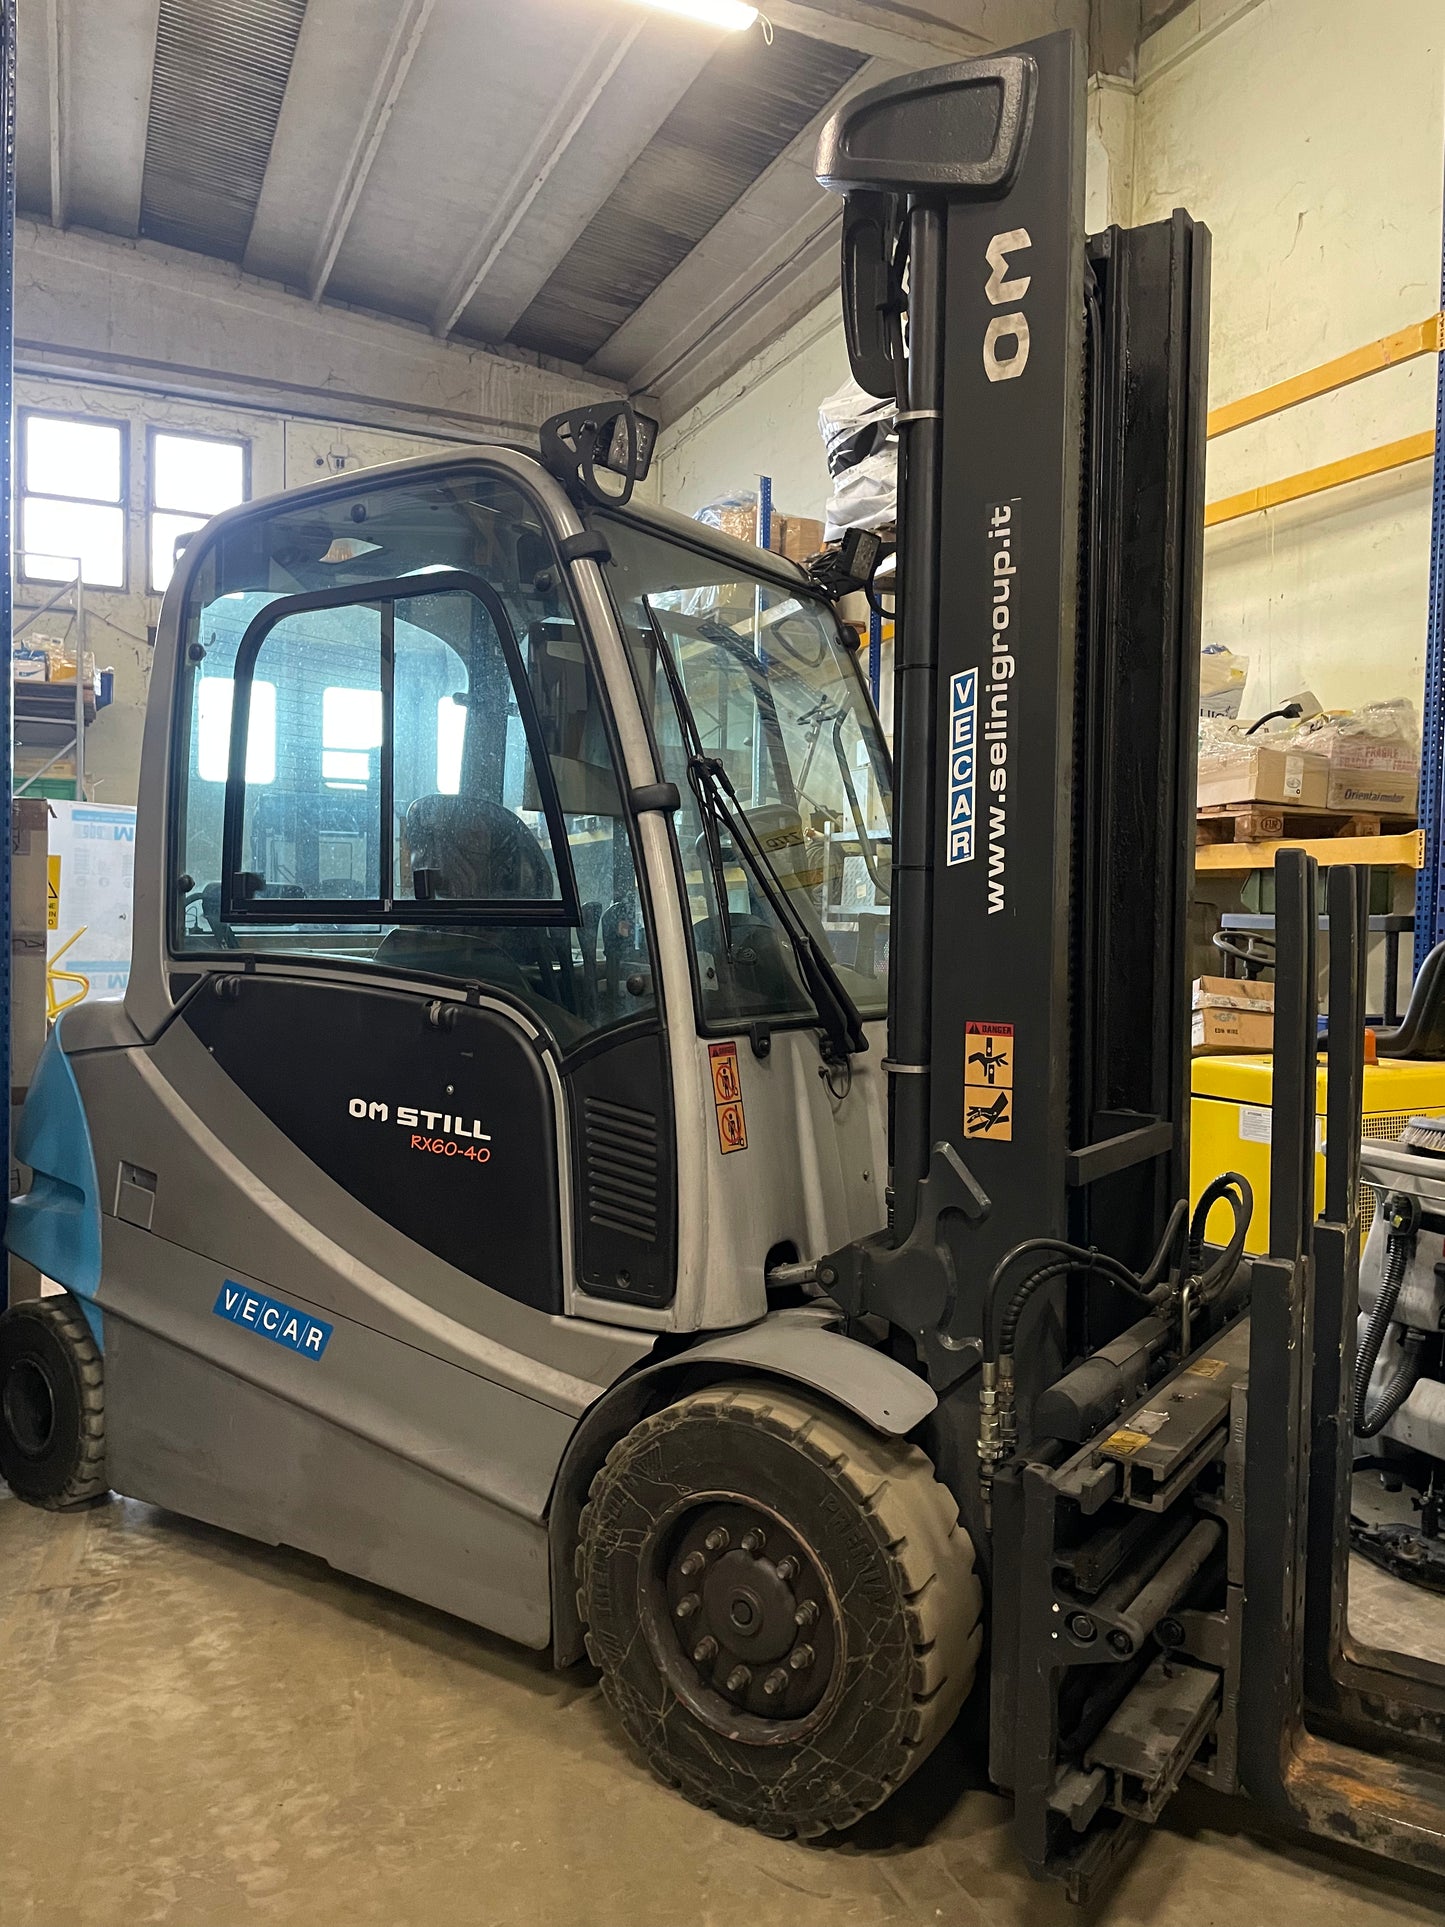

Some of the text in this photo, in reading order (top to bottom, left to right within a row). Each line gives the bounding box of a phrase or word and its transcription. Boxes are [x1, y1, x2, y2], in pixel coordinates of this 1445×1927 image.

[982, 227, 1032, 382] OM
[985, 504, 1018, 915] www.selinigroup.it
[951, 677, 975, 858] VECAR
[981, 1025, 1012, 1035] DANGER
[348, 1098, 492, 1141] OM STILL
[410, 1134, 491, 1163] RX60-40
[224, 1288, 324, 1352] VECAR
